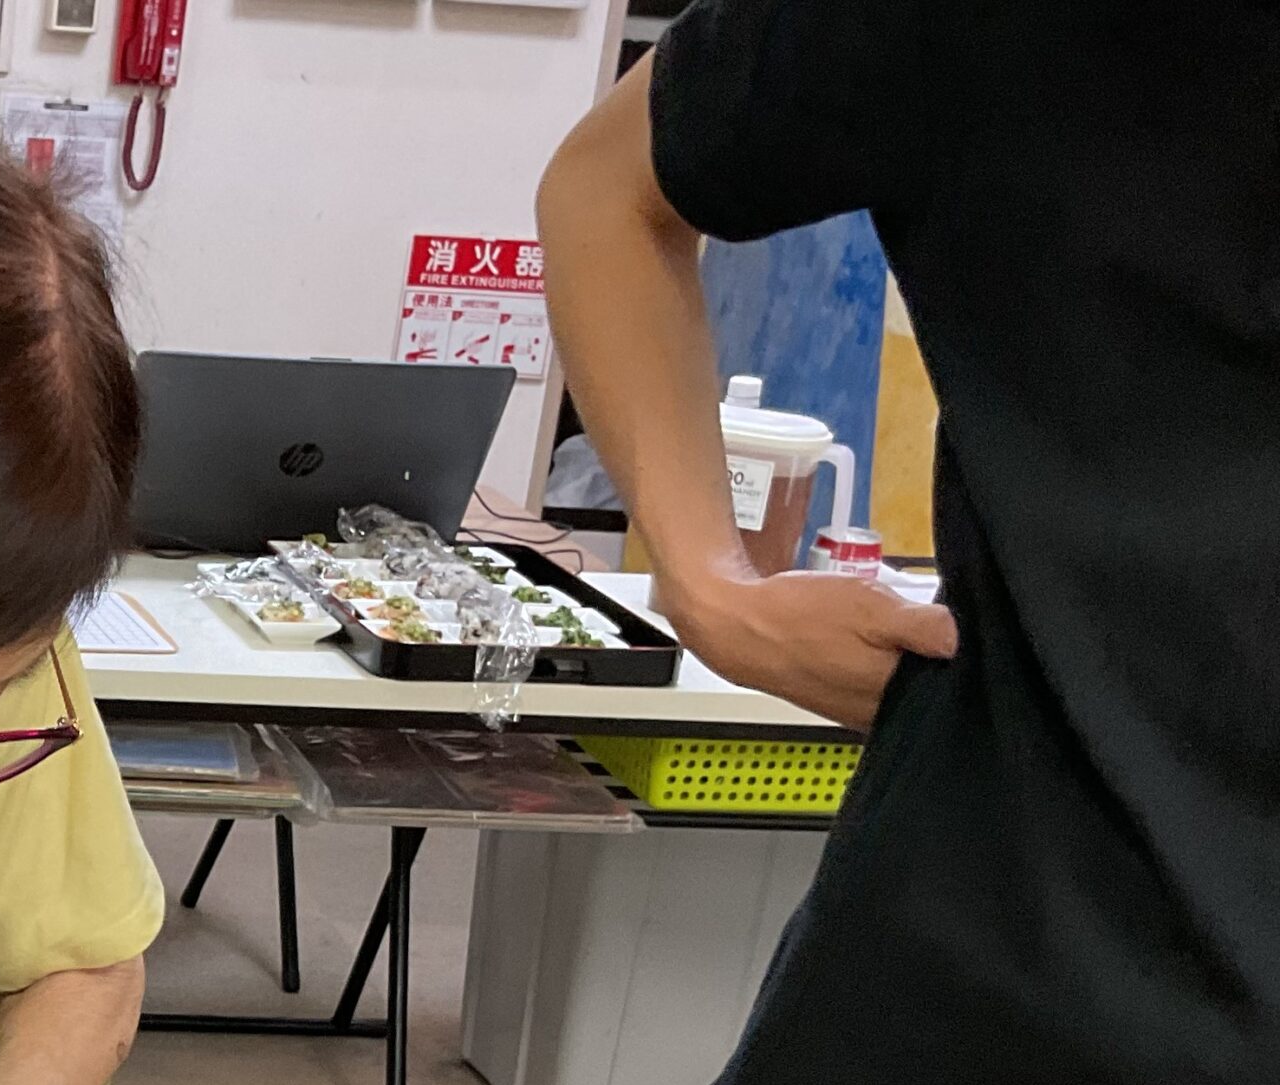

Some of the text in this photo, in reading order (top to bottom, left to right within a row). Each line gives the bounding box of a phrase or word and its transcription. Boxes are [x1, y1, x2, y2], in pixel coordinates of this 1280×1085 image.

[426, 240, 544, 276] 消火器
[420, 273, 448, 285] FIRE
